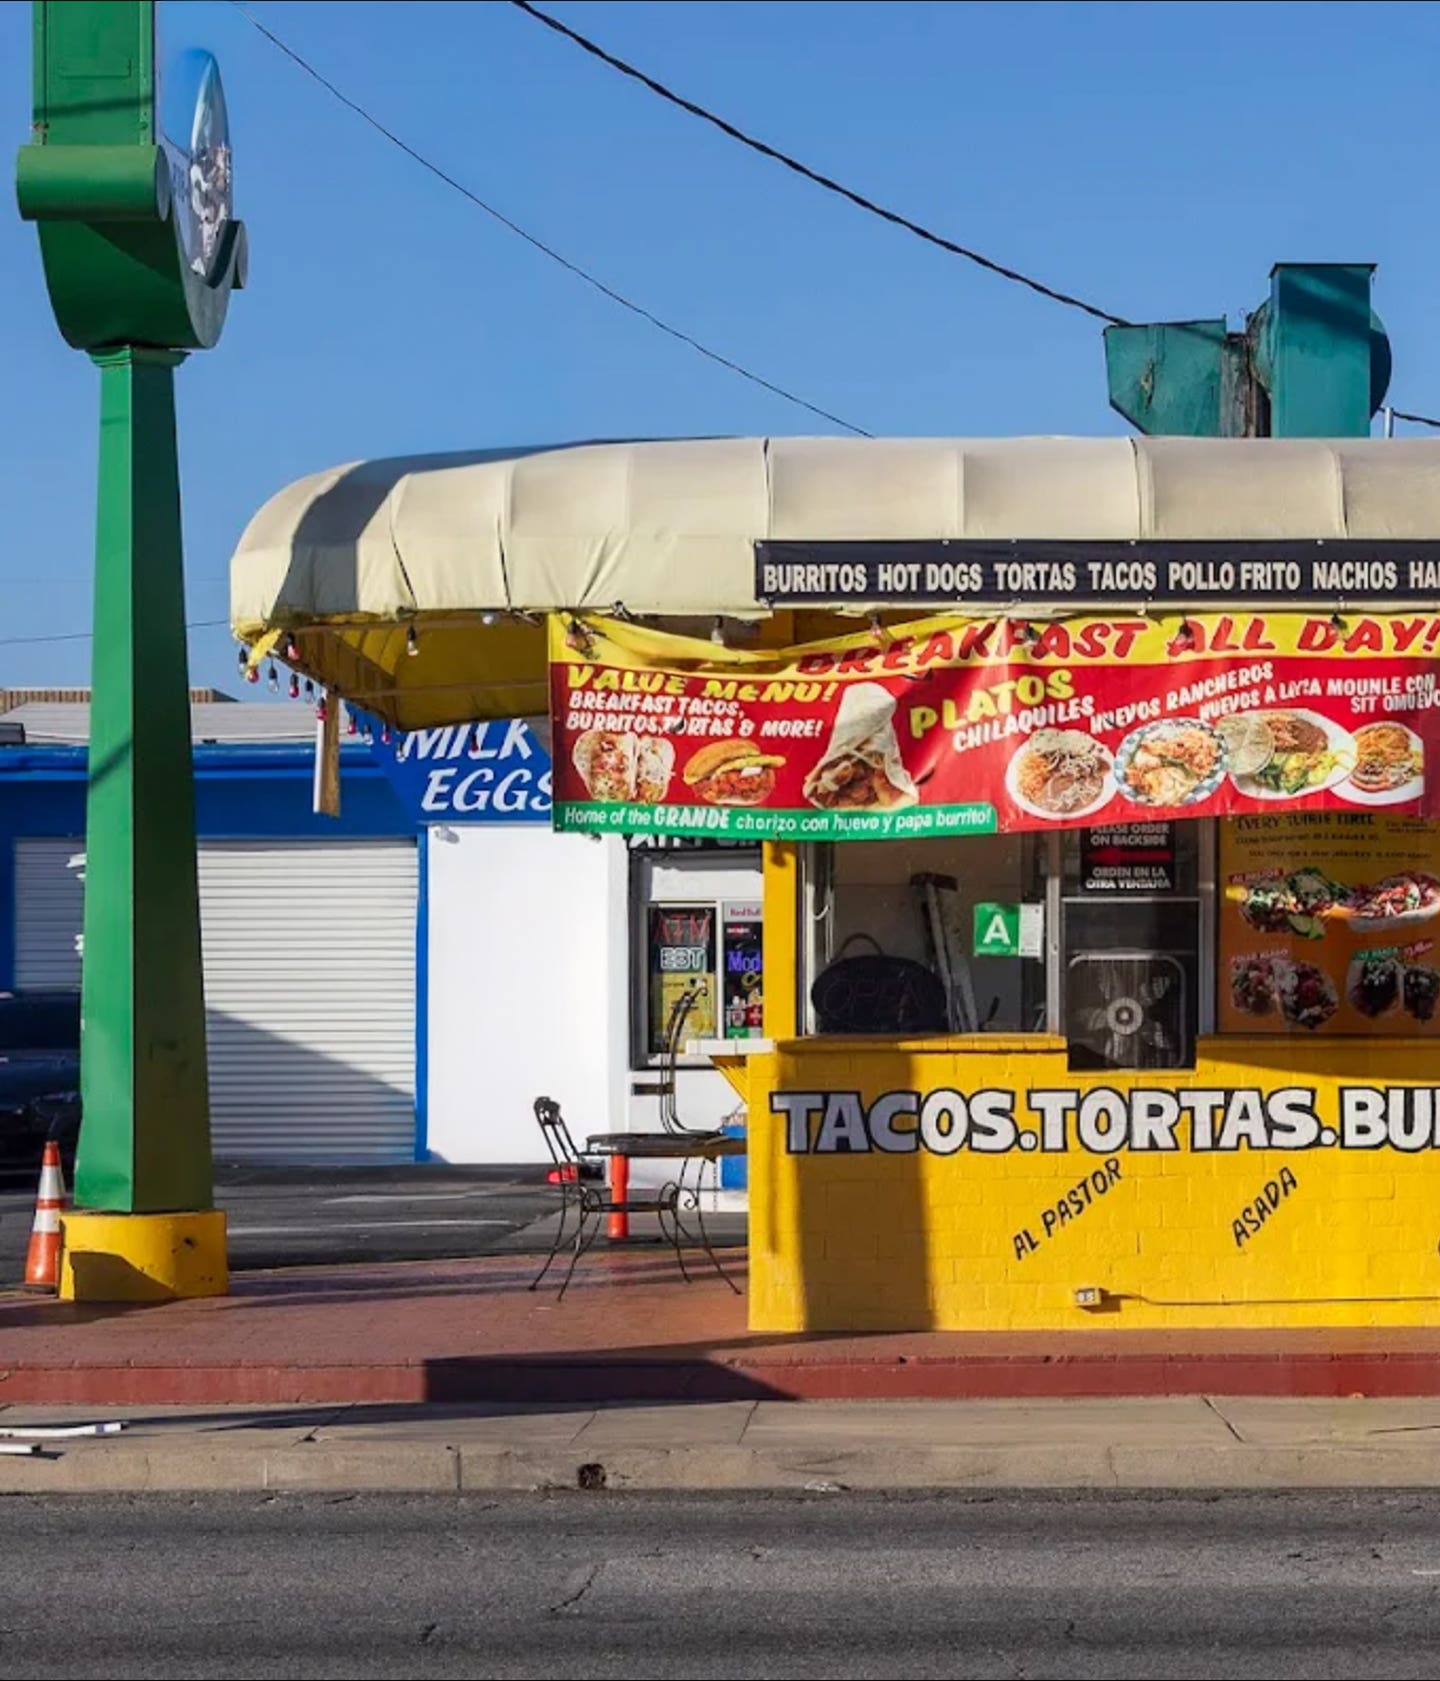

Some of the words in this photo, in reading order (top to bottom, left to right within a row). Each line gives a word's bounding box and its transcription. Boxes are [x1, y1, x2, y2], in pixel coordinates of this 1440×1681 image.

[763, 563, 868, 593] BURRITOS
[877, 563, 921, 592] HOT
[926, 563, 983, 592] DOGS
[993, 562, 1077, 592] TORTAS
[1087, 562, 1157, 592] TACOS
[1168, 561, 1235, 590] POLLO
[1240, 561, 1301, 590] FRITO
[1312, 561, 1398, 590] NACHOS
[796, 619, 1148, 675] BREAKFAST
[1167, 616, 1276, 657] ALL
[567, 665, 688, 695] VALUE
[1263, 685, 1276, 704] A
[1405, 673, 1436, 692] CON
[569, 691, 675, 712] BREAKFAST
[678, 696, 746, 719] TACOS,
[908, 669, 1075, 739] PLATOS
[1090, 697, 1161, 734] HUEVOS
[1165, 661, 1274, 711] RANCHEROS
[402, 718, 533, 761] MILK
[738, 720, 755, 737] &
[759, 719, 824, 738] MORE!
[952, 694, 1095, 754] CHILAQUILES
[420, 767, 552, 812] EGGS
[564, 806, 607, 826] Home
[609, 807, 626, 826] of
[627, 808, 651, 826] the
[653, 808, 730, 830] GRANDE
[735, 815, 797, 831] chorizo
[800, 817, 829, 831] con
[833, 814, 880, 832] huevo
[881, 816, 892, 834] y
[894, 813, 933, 834] papa
[934, 808, 992, 828] burrito!
[1089, 824, 1128, 834] PLEASE
[1130, 823, 1170, 834] ORDER
[1090, 834, 1110, 846] ON
[1112, 834, 1167, 846] BACKSIDE
[1085, 878, 1116, 889] OTRA
[1092, 867, 1131, 877] ORDEN
[1133, 867, 1149, 877] EN
[1151, 867, 1166, 877] LA
[654, 911, 712, 945] ATM
[982, 913, 1011, 945] A
[660, 947, 707, 971] EBT
[1011, 1231, 1041, 1262] AL
[1040, 1157, 1124, 1239] PASTOR
[1231, 1166, 1299, 1249] ASADA
